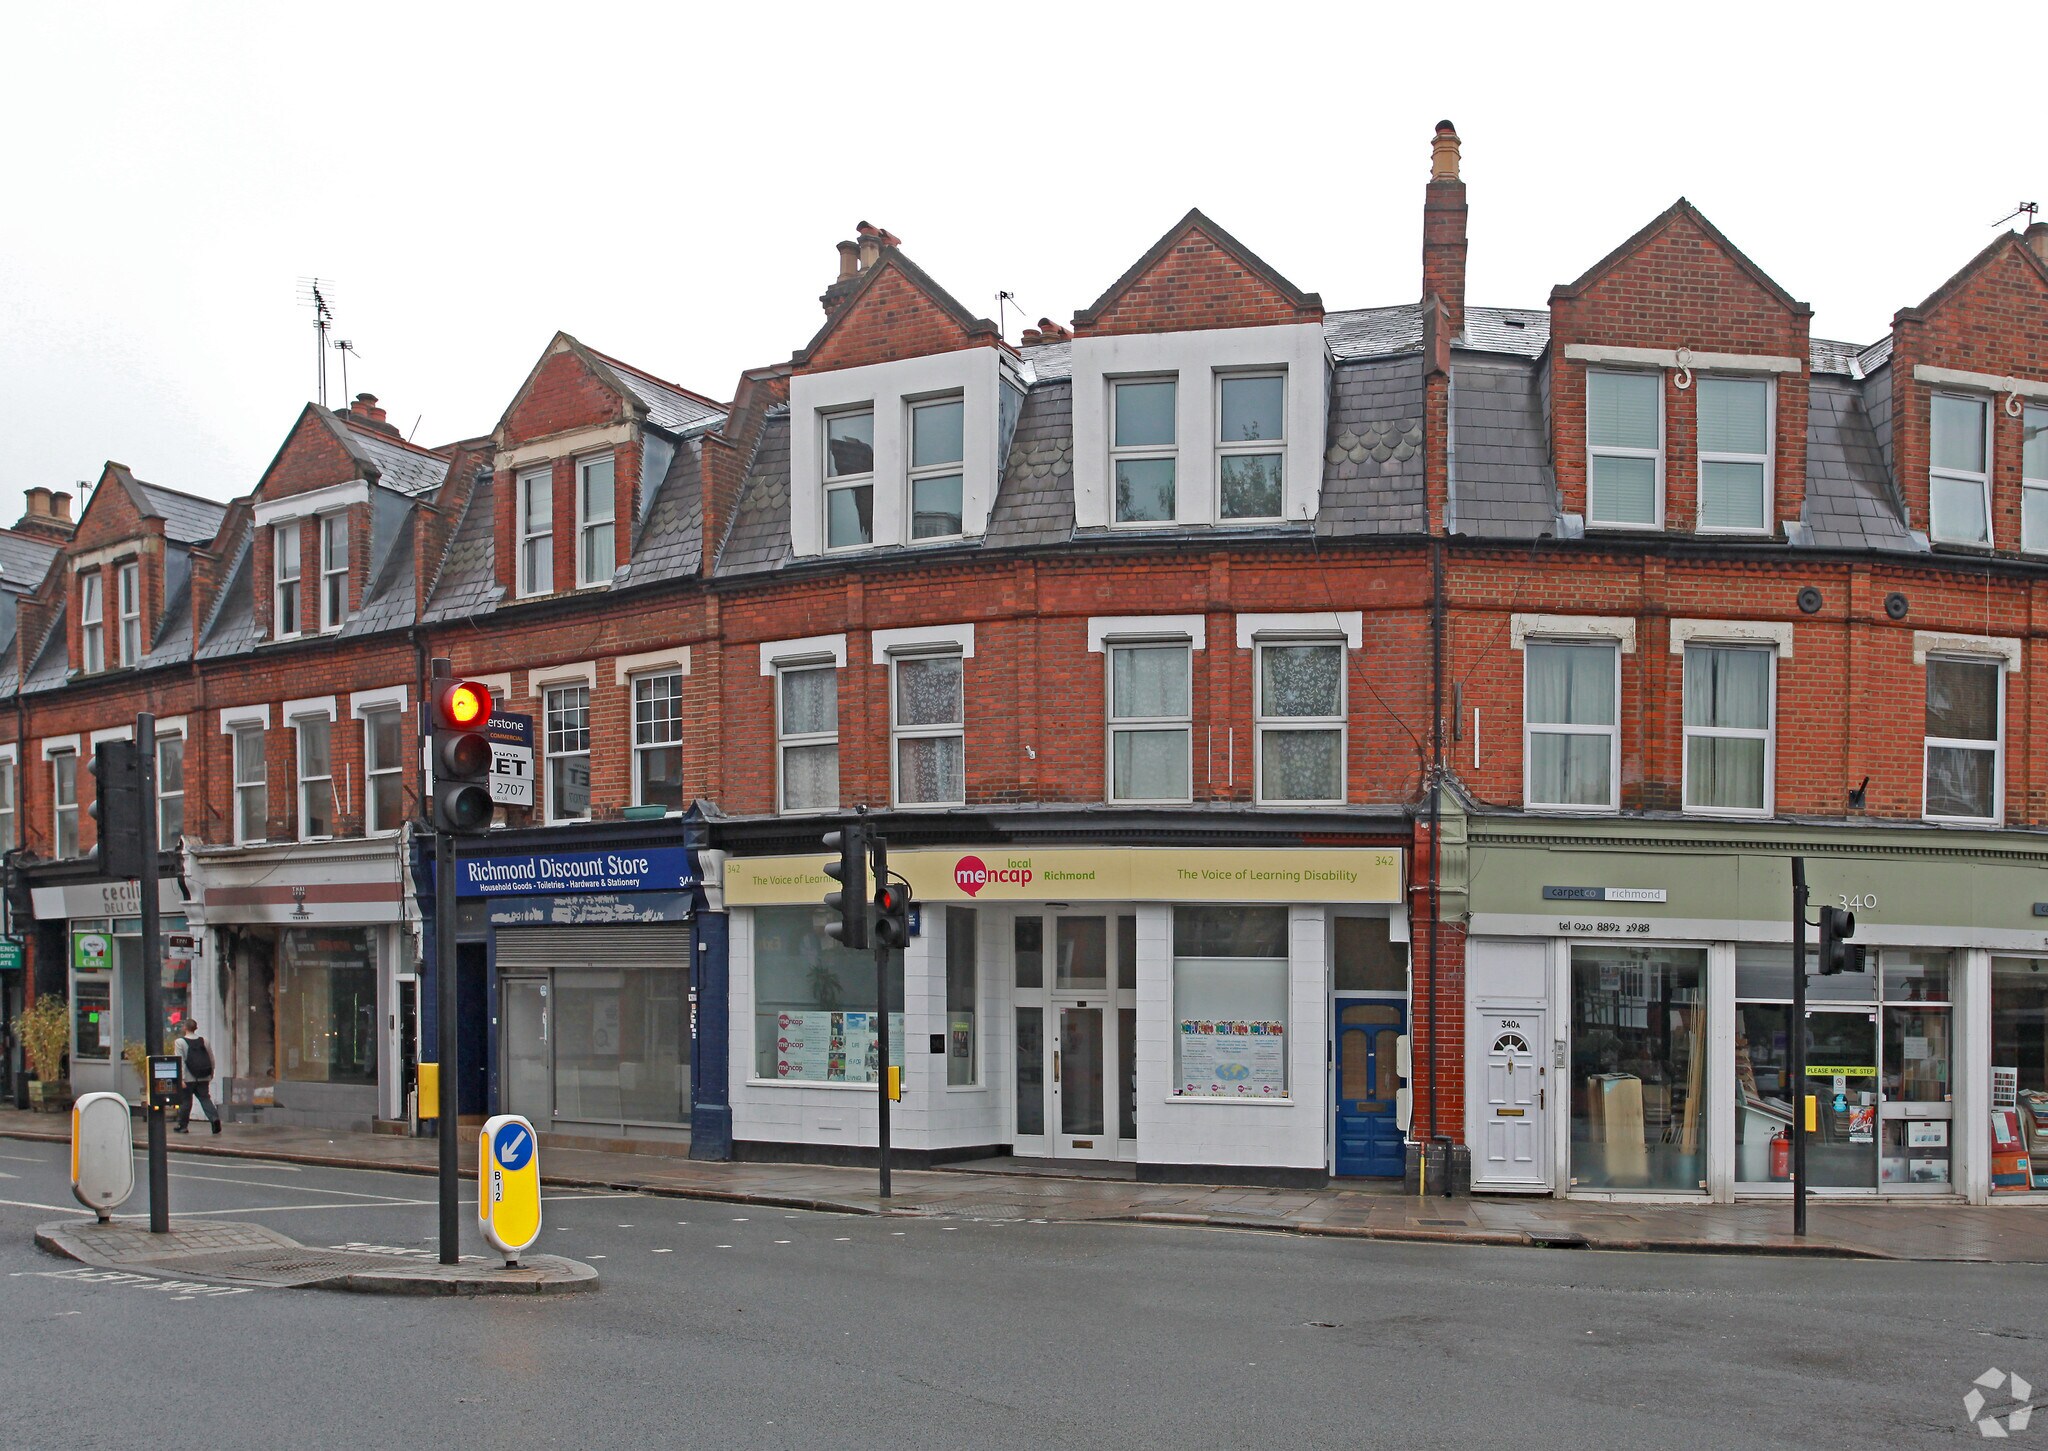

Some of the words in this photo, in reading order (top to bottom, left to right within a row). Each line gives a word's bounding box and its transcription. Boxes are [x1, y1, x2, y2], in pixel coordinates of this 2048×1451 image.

[490, 732, 523, 741] COMMERCIAL
[490, 758, 526, 776] ET
[496, 782, 524, 796] 2707
[1007, 858, 1032, 868] local
[1375, 856, 1394, 866] 342
[468, 858, 536, 882] Richmond
[540, 857, 604, 878] Discount
[608, 855, 649, 876] Store
[727, 864, 740, 874] 342
[752, 876, 768, 885] The
[769, 876, 792, 885] Voice
[794, 874, 803, 884] of
[956, 869, 1033, 887] mencap
[1044, 870, 1095, 881] Richmond
[1177, 869, 1198, 880] The
[1201, 869, 1232, 880] Voice
[1235, 868, 1248, 880] of
[1250, 869, 1301, 883] Learning
[1304, 869, 1358, 883] Disability
[480, 882, 512, 892] Household
[512, 882, 532, 890] Goods
[536, 880, 565, 889] Toiletries
[569, 880, 600, 888] Hardware
[601, 878, 606, 887] &
[607, 878, 640, 888] Stationery
[1552, 887, 1596, 899] carpetco
[1612, 889, 1660, 899] richmond
[104, 903, 124, 913] DELI
[1838, 894, 1877, 913] 340
[1559, 921, 1571, 931] tel
[1574, 922, 1593, 932] 020
[1597, 922, 1620, 932] 8892
[1626, 923, 1650, 933] 2988
[1501, 1020, 1520, 1029] 340A
